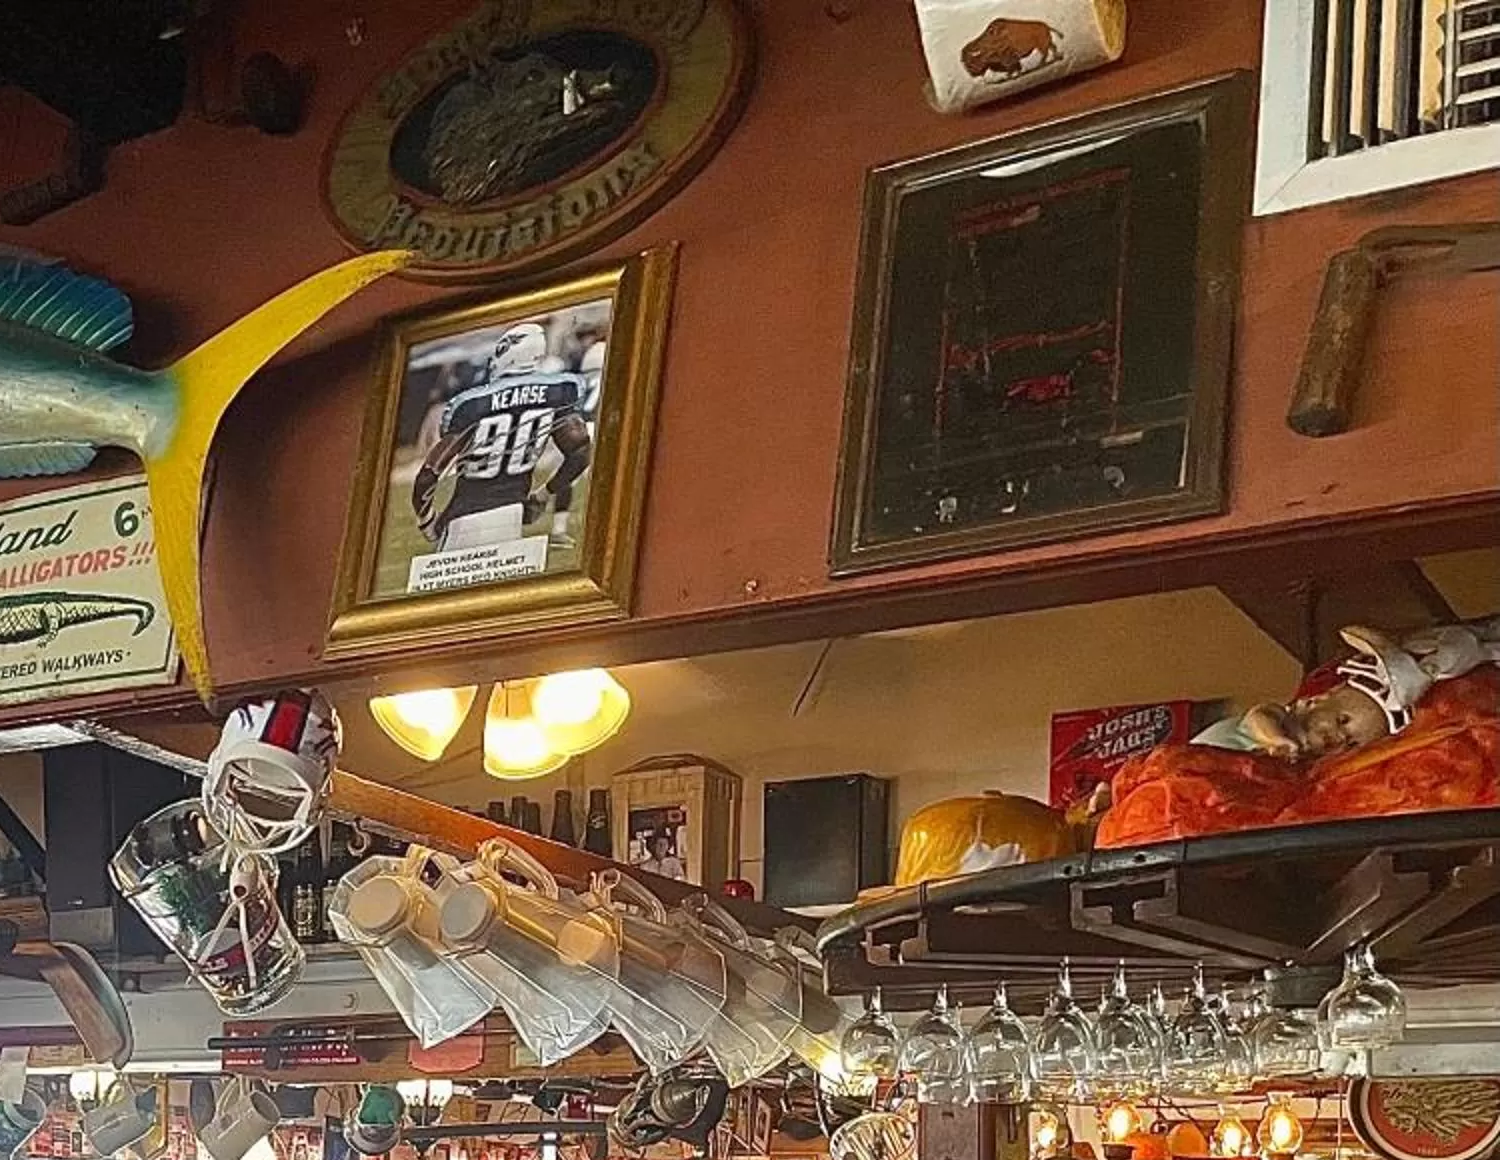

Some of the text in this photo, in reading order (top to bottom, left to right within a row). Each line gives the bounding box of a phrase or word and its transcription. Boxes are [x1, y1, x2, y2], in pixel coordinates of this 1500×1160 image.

[491, 385, 548, 411] KEARSE
[462, 407, 555, 479] 90
[425, 549, 498, 570] JEVON KEARSE
[419, 568, 444, 581] HIGH
[445, 562, 484, 576] SCHOOL
[42, 650, 124, 673] WALKWAYS
